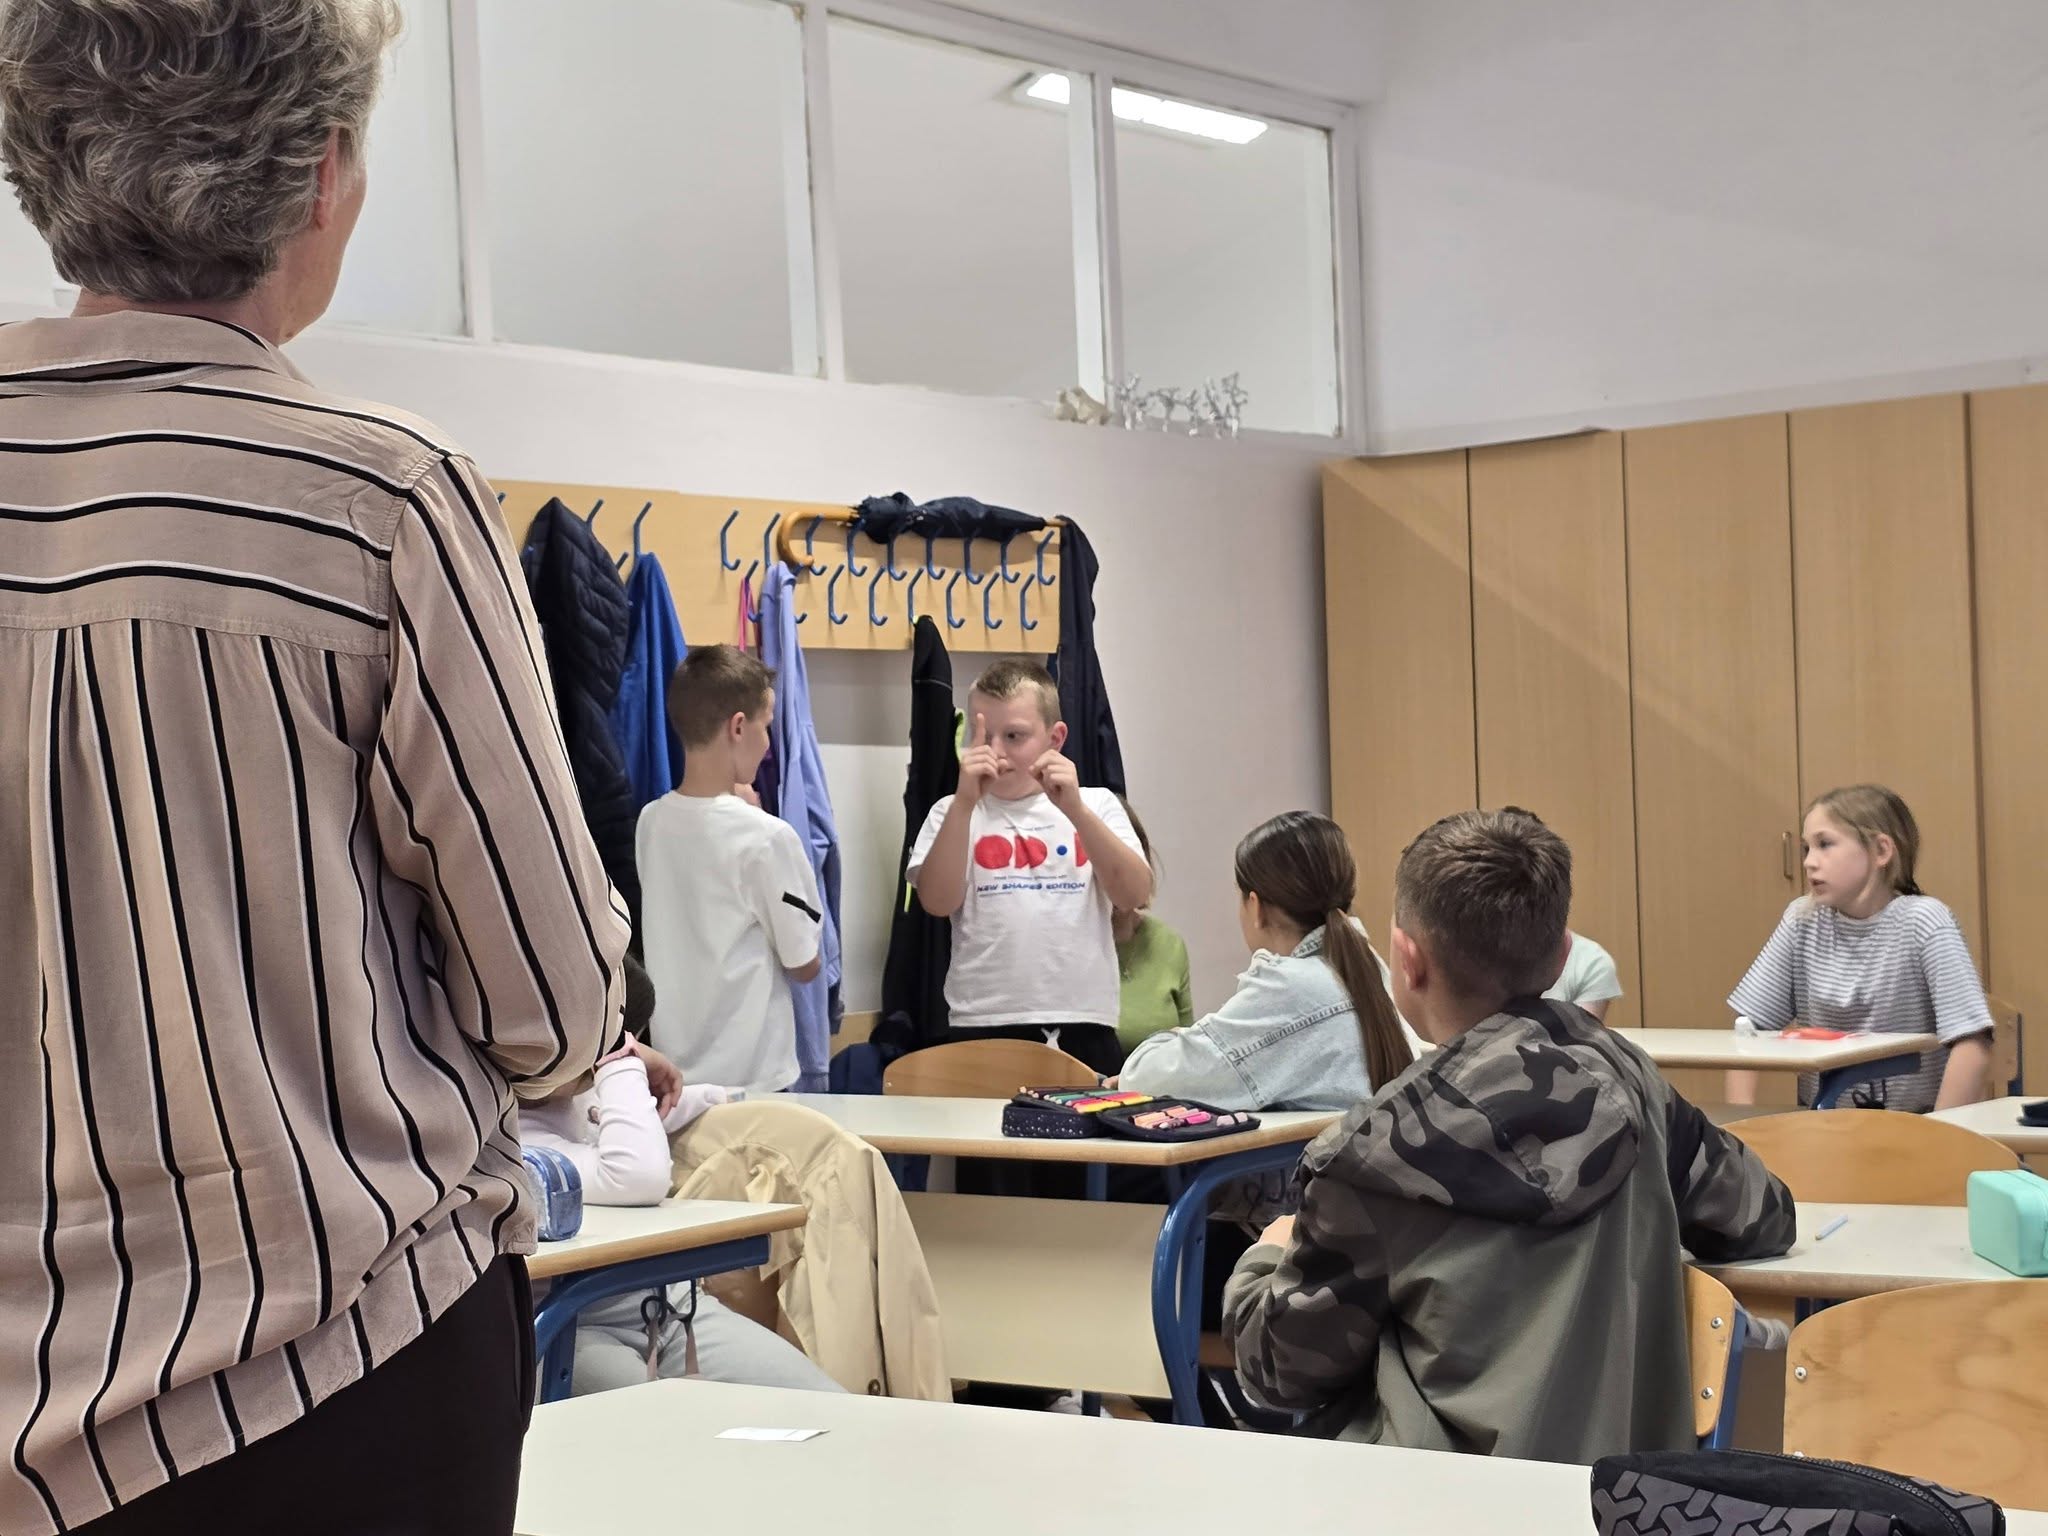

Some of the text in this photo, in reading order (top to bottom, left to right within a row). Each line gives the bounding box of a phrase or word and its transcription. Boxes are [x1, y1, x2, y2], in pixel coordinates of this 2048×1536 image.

[976, 881, 1086, 893] NEW SHAPES EDITION
